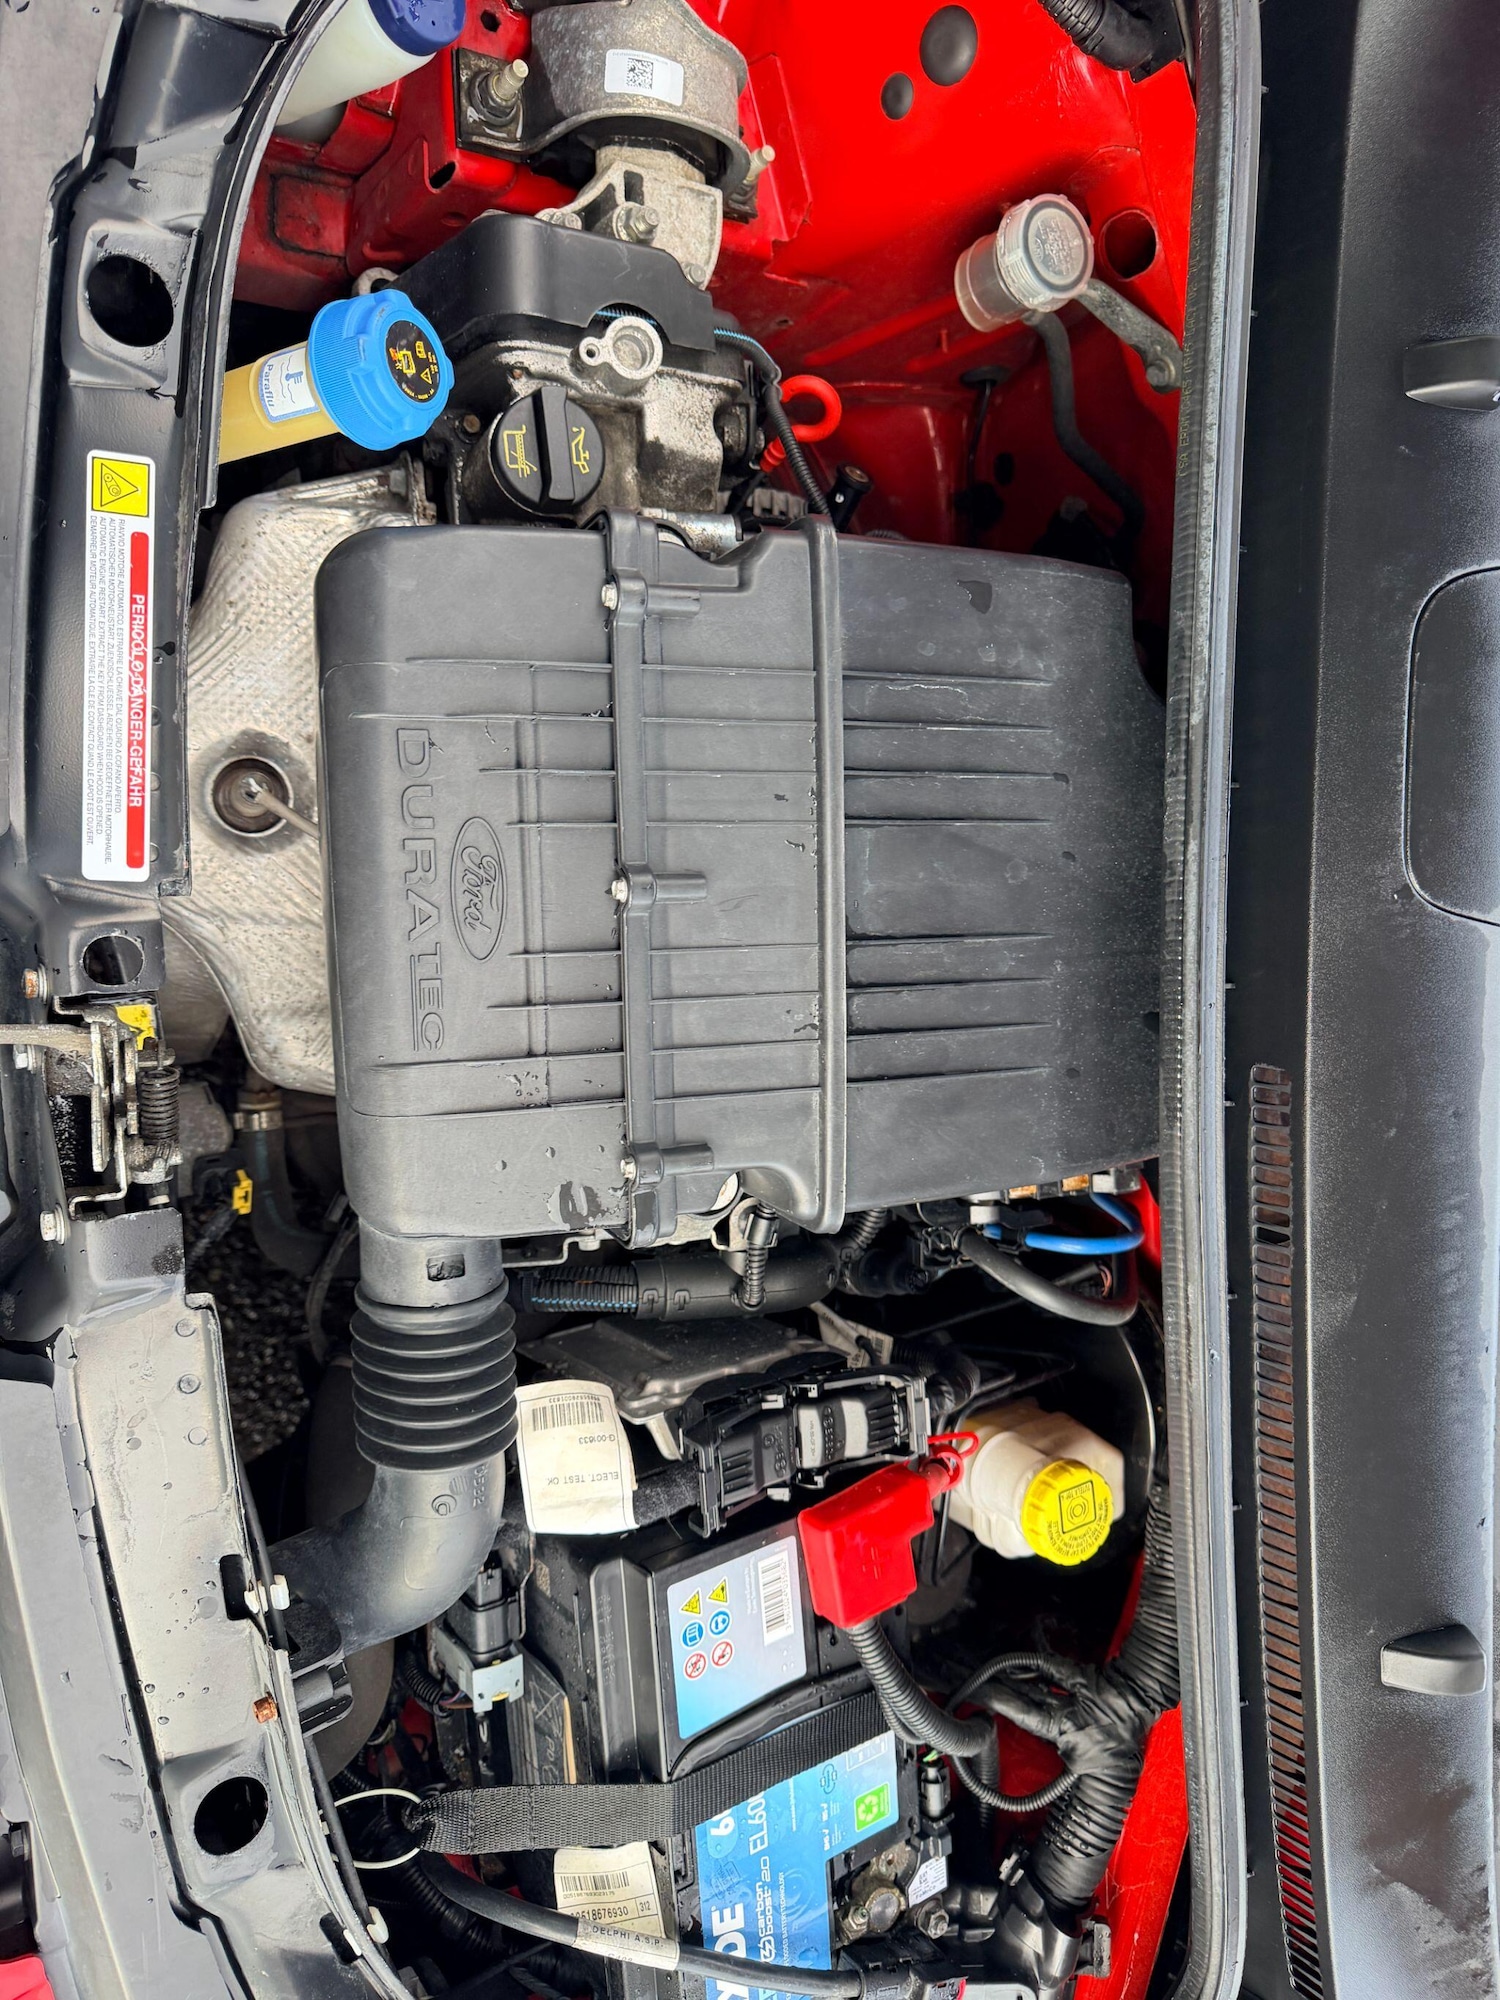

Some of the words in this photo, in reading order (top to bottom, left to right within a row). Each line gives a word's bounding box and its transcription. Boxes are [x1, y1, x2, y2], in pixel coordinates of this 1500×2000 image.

[262, 364, 275, 407] Paraflu
[98, 516, 106, 556] AUTOMATIC
[107, 518, 115, 577] AUTOMATISCHER
[117, 519, 125, 547] RIAVVIO
[116, 548, 124, 578] MOTORE
[115, 627, 123, 665] ESTRARRE
[88, 676, 94, 685] LA
[105, 642, 113, 713] ZUENDSCHLUESSEL
[115, 666, 123, 675] LA
[115, 676, 123, 701] CHIAVE
[87, 700, 94, 709] DE
[114, 717, 122, 748] QUADRO
[87, 768, 93, 777] LE
[114, 755, 122, 784] COFANO
[104, 761, 112, 813] GEOEFFNETER
[396, 728, 443, 1052] DURATEC
[461, 845, 500, 931] Ford
[563, 1473, 584, 1484] TEST
[639, 1901, 651, 1912] 312
[755, 1882, 766, 1938] carbon
[763, 1888, 774, 1936] boost
[592, 1925, 631, 1940] DELPHI
